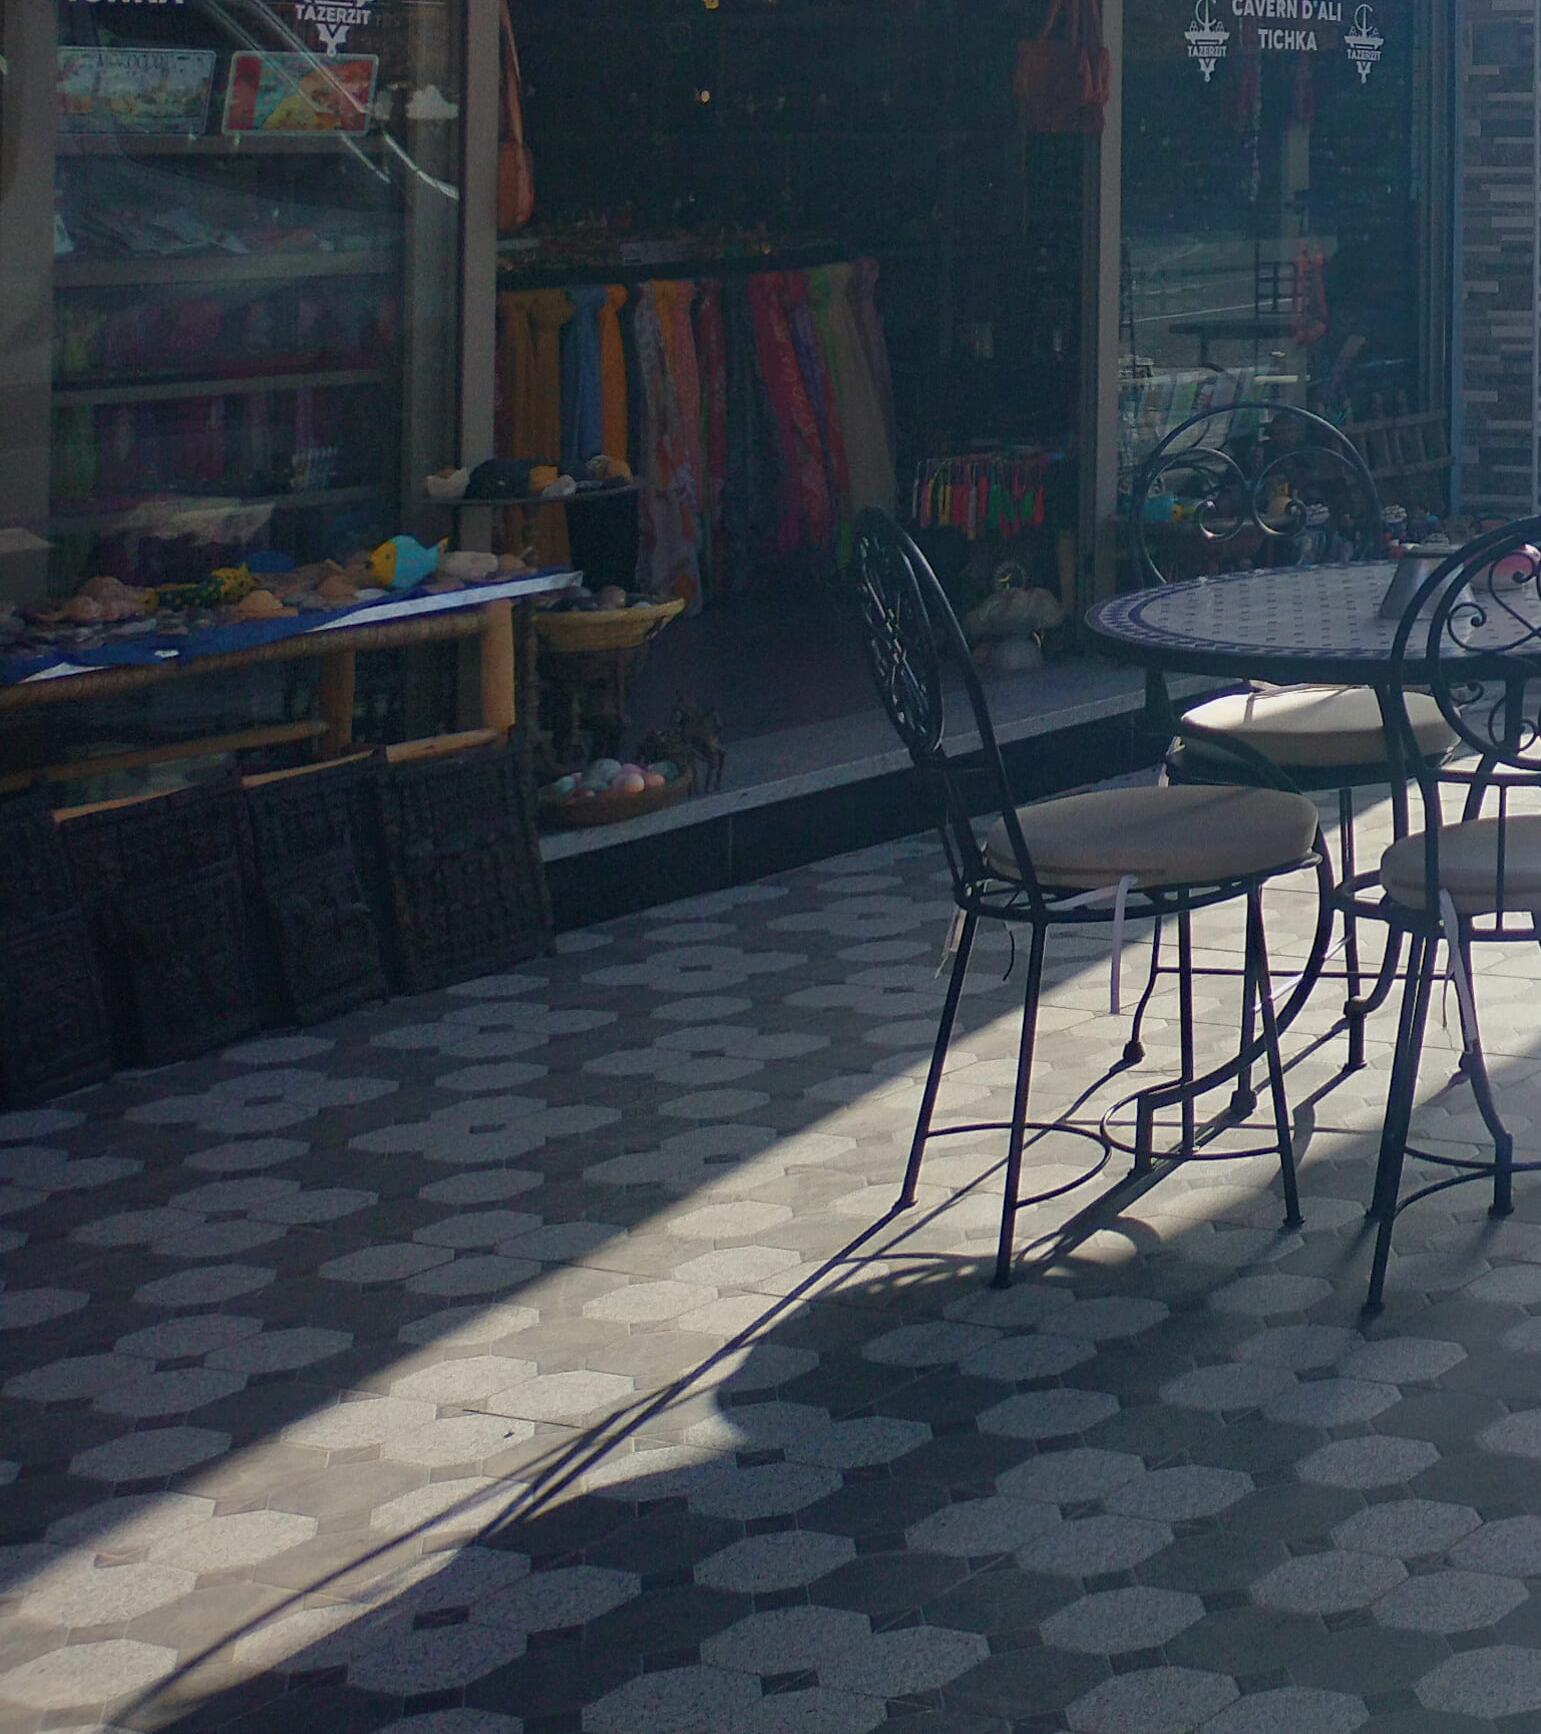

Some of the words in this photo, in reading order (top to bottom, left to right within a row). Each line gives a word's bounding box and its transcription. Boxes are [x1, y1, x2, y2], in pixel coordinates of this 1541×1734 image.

[295, 4, 371, 26] TAZERZIT
[1301, 0, 1342, 22] D'ALI
[1257, 28, 1318, 51] TICHKA
[1187, 44, 1227, 58] TAZERZIT
[1346, 48, 1382, 62] TAZERZIT
